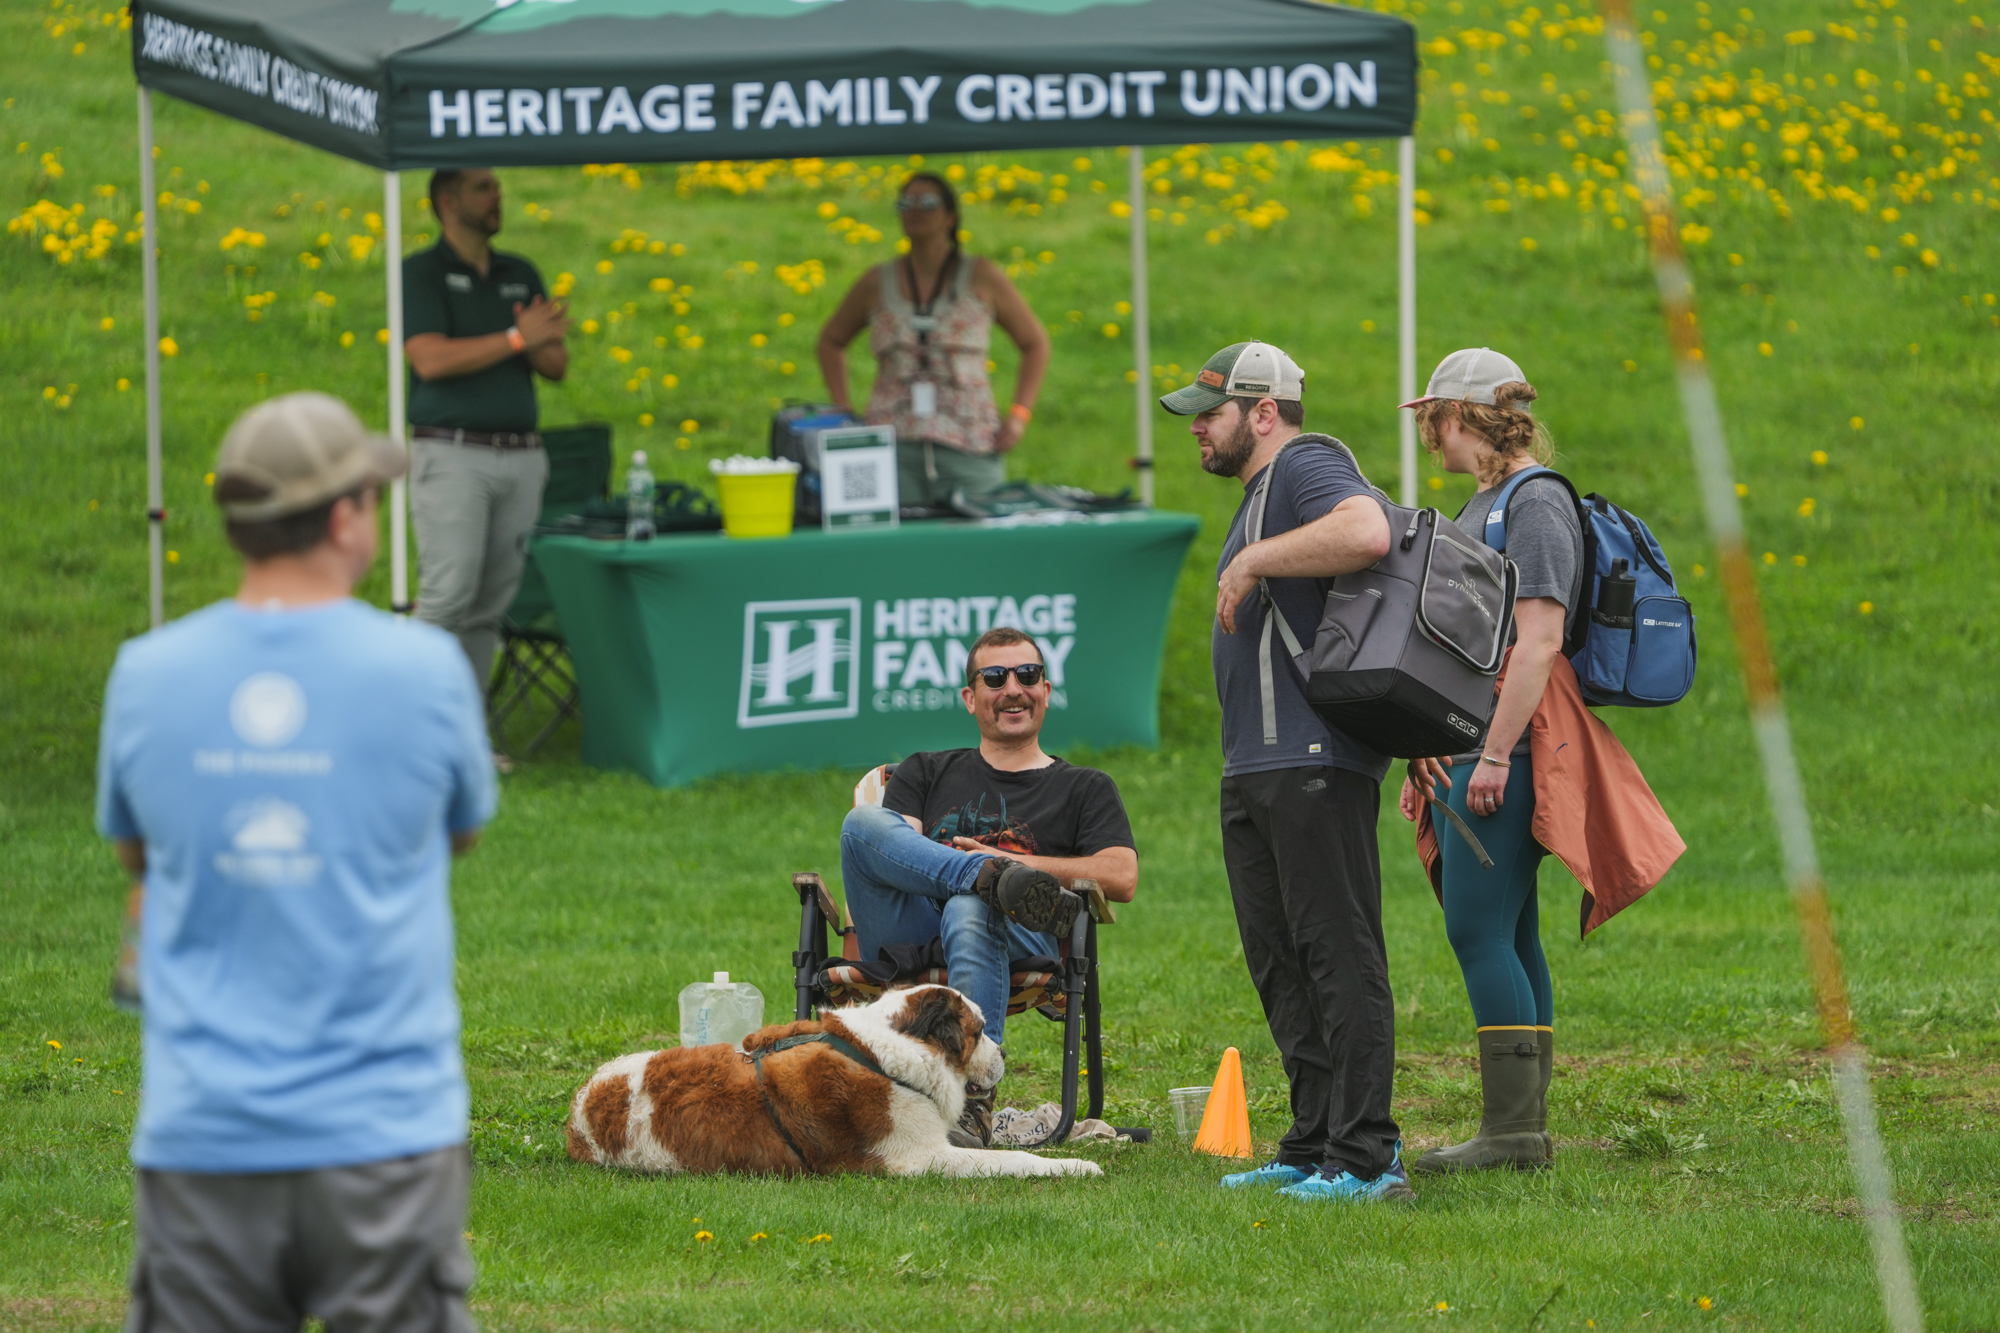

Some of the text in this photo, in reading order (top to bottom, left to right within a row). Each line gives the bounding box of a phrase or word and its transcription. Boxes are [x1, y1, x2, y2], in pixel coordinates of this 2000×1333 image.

[428, 59, 1378, 138] HERITAGE FAMILY CREDIT UNION
[872, 593, 1078, 640] HERITAGE
[1447, 713, 1479, 738] OGIO
